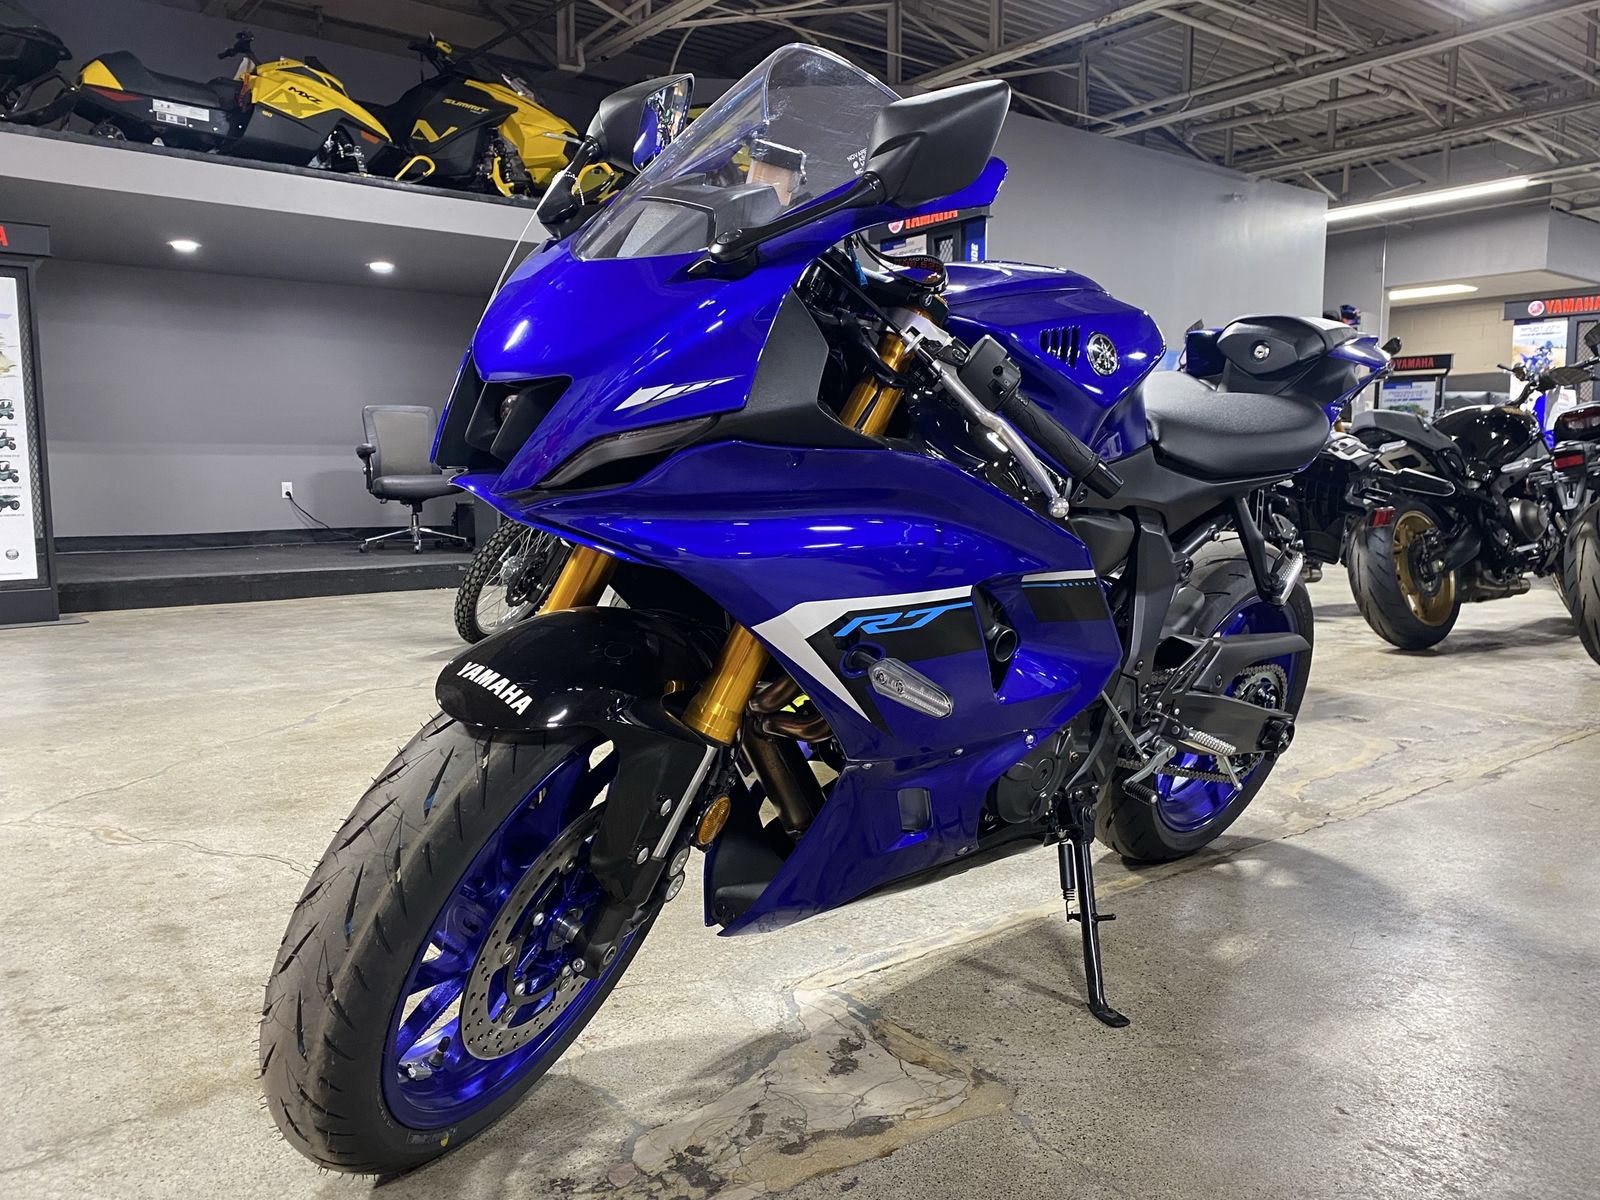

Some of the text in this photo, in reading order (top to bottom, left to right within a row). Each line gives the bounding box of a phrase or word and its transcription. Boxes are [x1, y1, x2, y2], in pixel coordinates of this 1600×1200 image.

[288, 86, 323, 105] MXZ
[442, 98, 490, 113] SUMMIT
[1545, 295, 1600, 314] YAMAHA
[1396, 357, 1435, 369] YAMAHA
[833, 601, 973, 637] R7
[456, 661, 533, 715] YAMAHA
